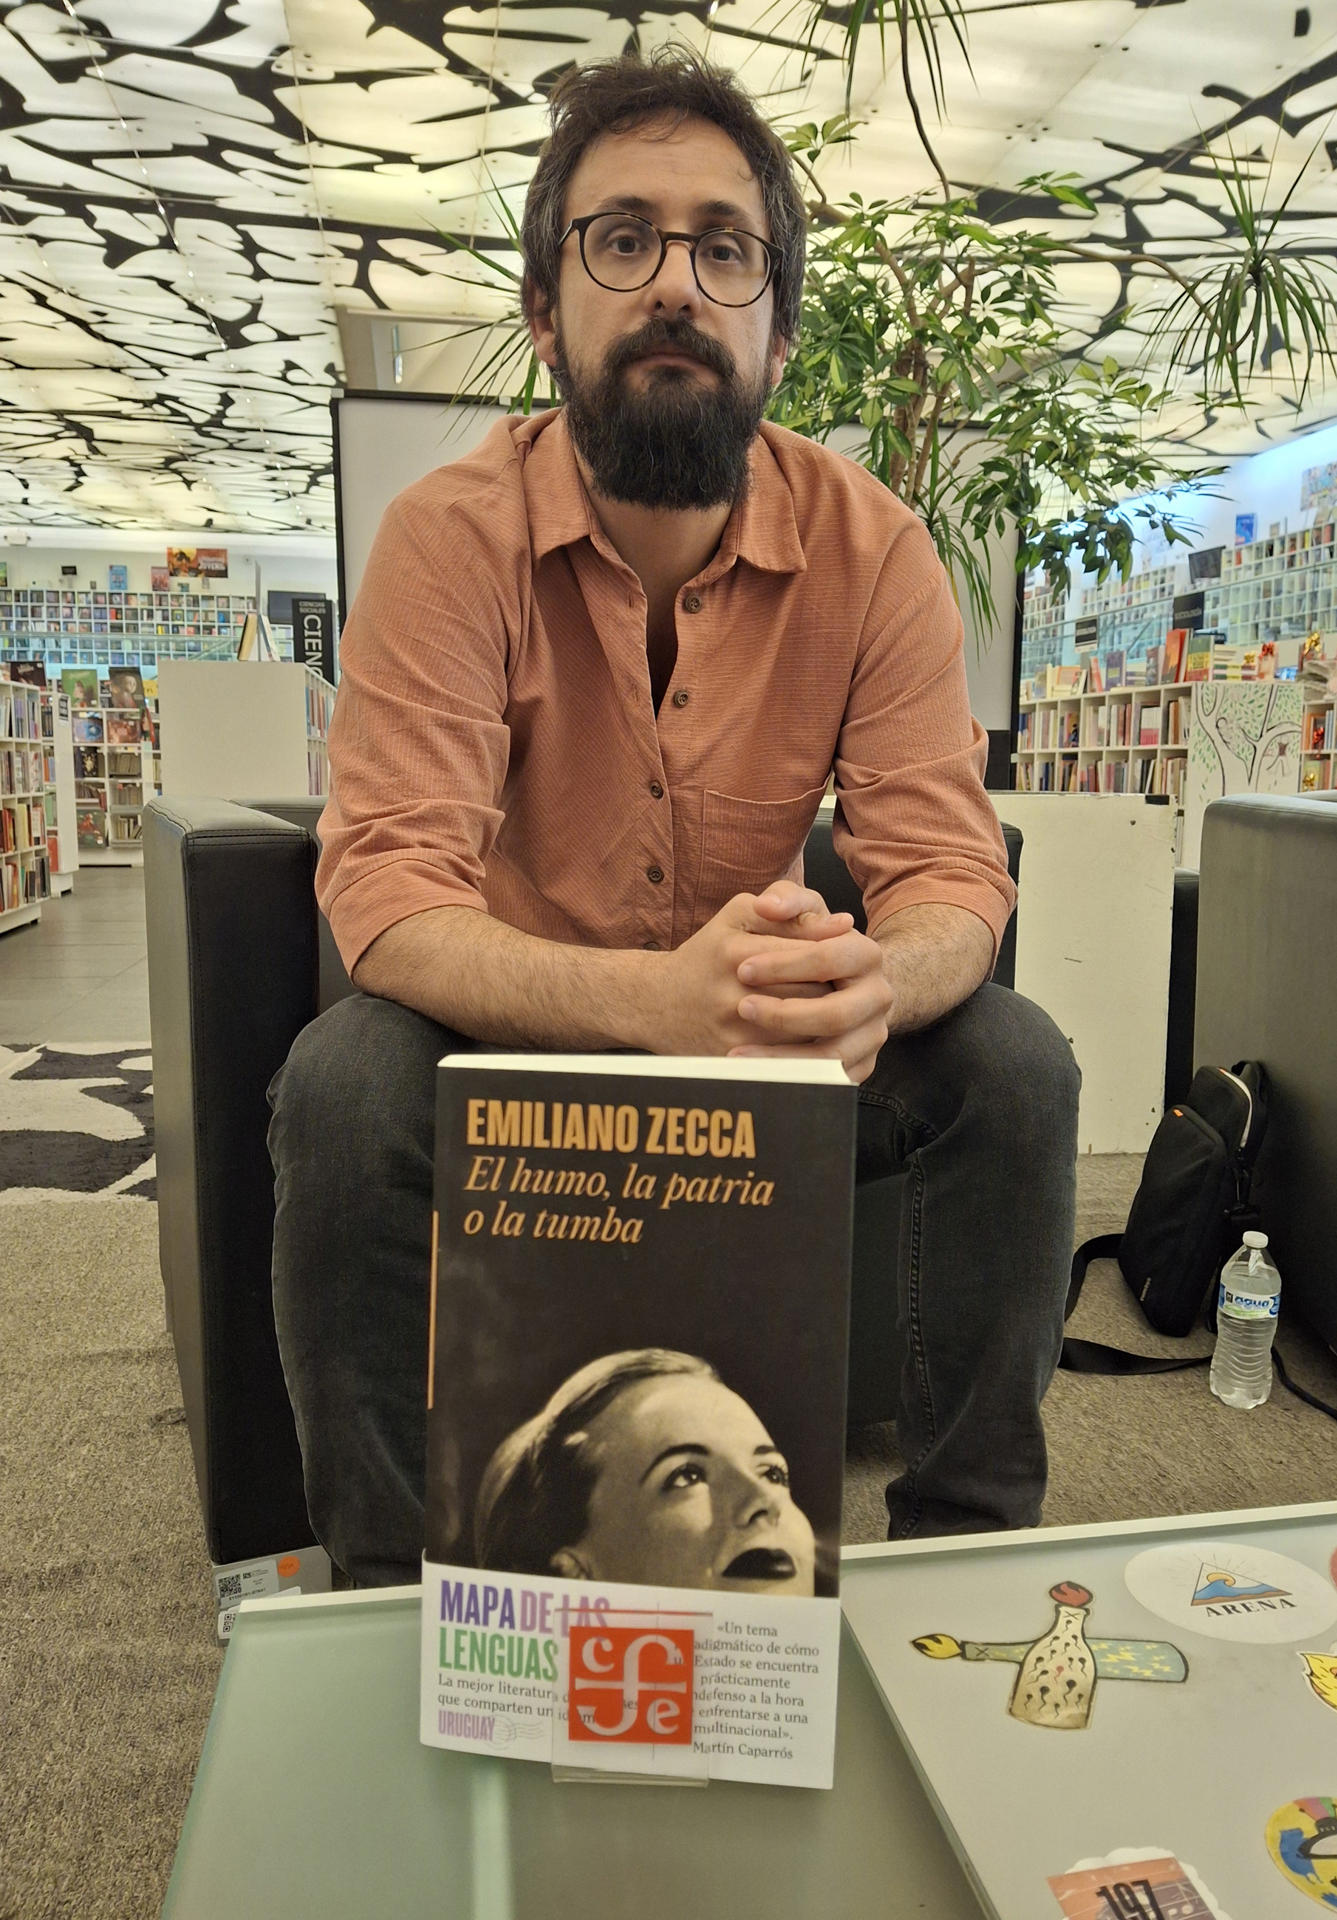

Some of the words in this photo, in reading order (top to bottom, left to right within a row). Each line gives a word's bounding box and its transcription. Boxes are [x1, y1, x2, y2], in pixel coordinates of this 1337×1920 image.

[466, 1098, 639, 1153] EMILIANO
[645, 1107, 756, 1159] ZECCA
[464, 1155, 504, 1192] El
[509, 1157, 610, 1201] humo,
[622, 1163, 656, 1200] la
[659, 1170, 775, 1210] patria
[464, 1209, 484, 1235] o
[491, 1201, 525, 1238] la
[533, 1206, 644, 1244] tumba
[440, 1580, 516, 1630] MAPA
[520, 1590, 554, 1634] DE
[1206, 1598, 1297, 1617] ARENA
[746, 1624, 778, 1637] tema
[439, 1627, 559, 1683] LENGUAS
[767, 1642, 781, 1654] de
[785, 1643, 820, 1656] cómo
[695, 1655, 736, 1669] Estado
[740, 1659, 752, 1669] se
[756, 1660, 819, 1674] encuentra
[438, 1673, 453, 1687] La
[457, 1679, 494, 1693] mejor
[700, 1672, 791, 1689] prácticamente
[438, 1694, 460, 1706] que
[464, 1697, 533, 1713] comparten
[537, 1707, 553, 1718] un
[750, 1693, 757, 1703] a
[761, 1692, 771, 1704] la
[775, 1693, 805, 1707] hora
[698, 1705, 770, 1720] enfrentarse
[773, 1713, 781, 1721] a
[784, 1713, 809, 1724] una
[438, 1709, 496, 1741] URUGUAY
[693, 1741, 734, 1754] Martín
[738, 1743, 793, 1759] Caparrós
